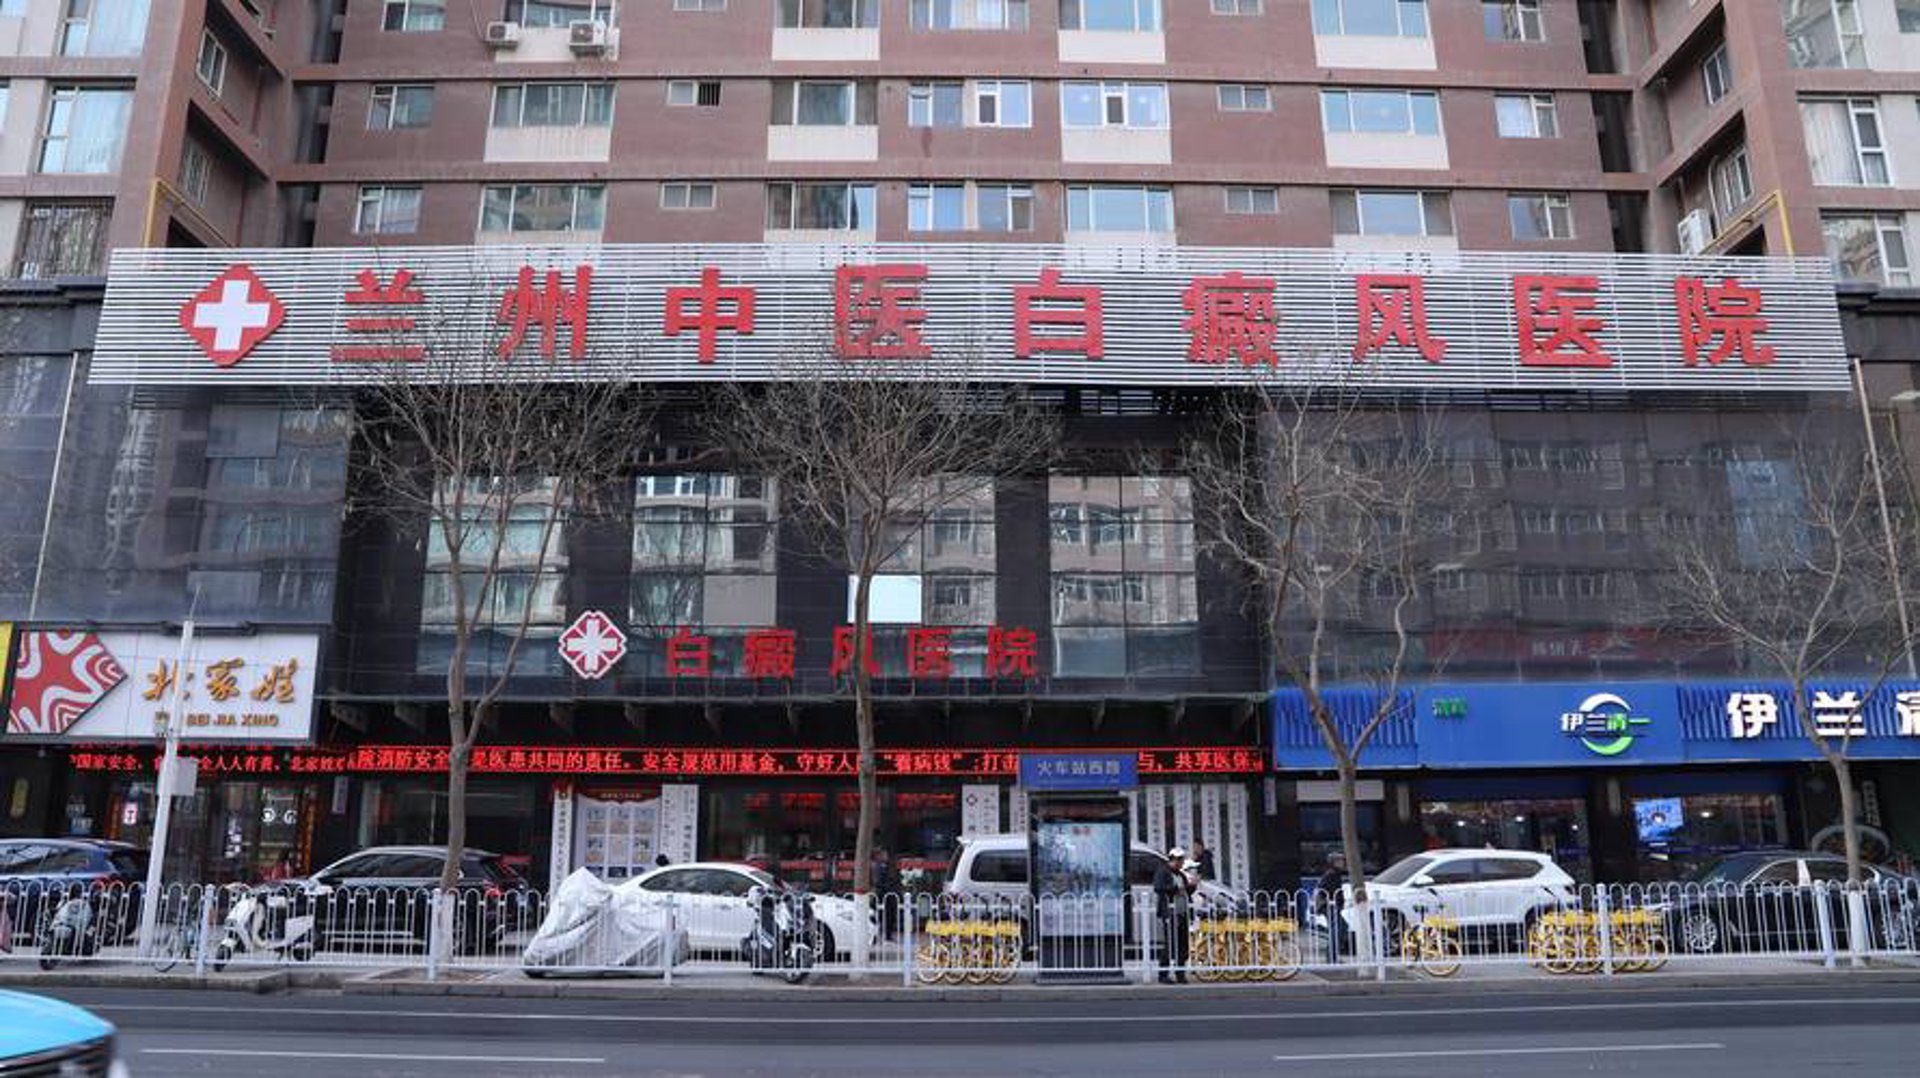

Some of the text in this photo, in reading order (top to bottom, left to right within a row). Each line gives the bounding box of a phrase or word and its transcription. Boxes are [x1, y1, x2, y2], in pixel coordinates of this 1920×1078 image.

[331, 263, 1777, 368] 兰州中医白癜风医院
[666, 624, 1037, 679] 白癜风医院
[187, 713, 280, 727] BEI JIA XING
